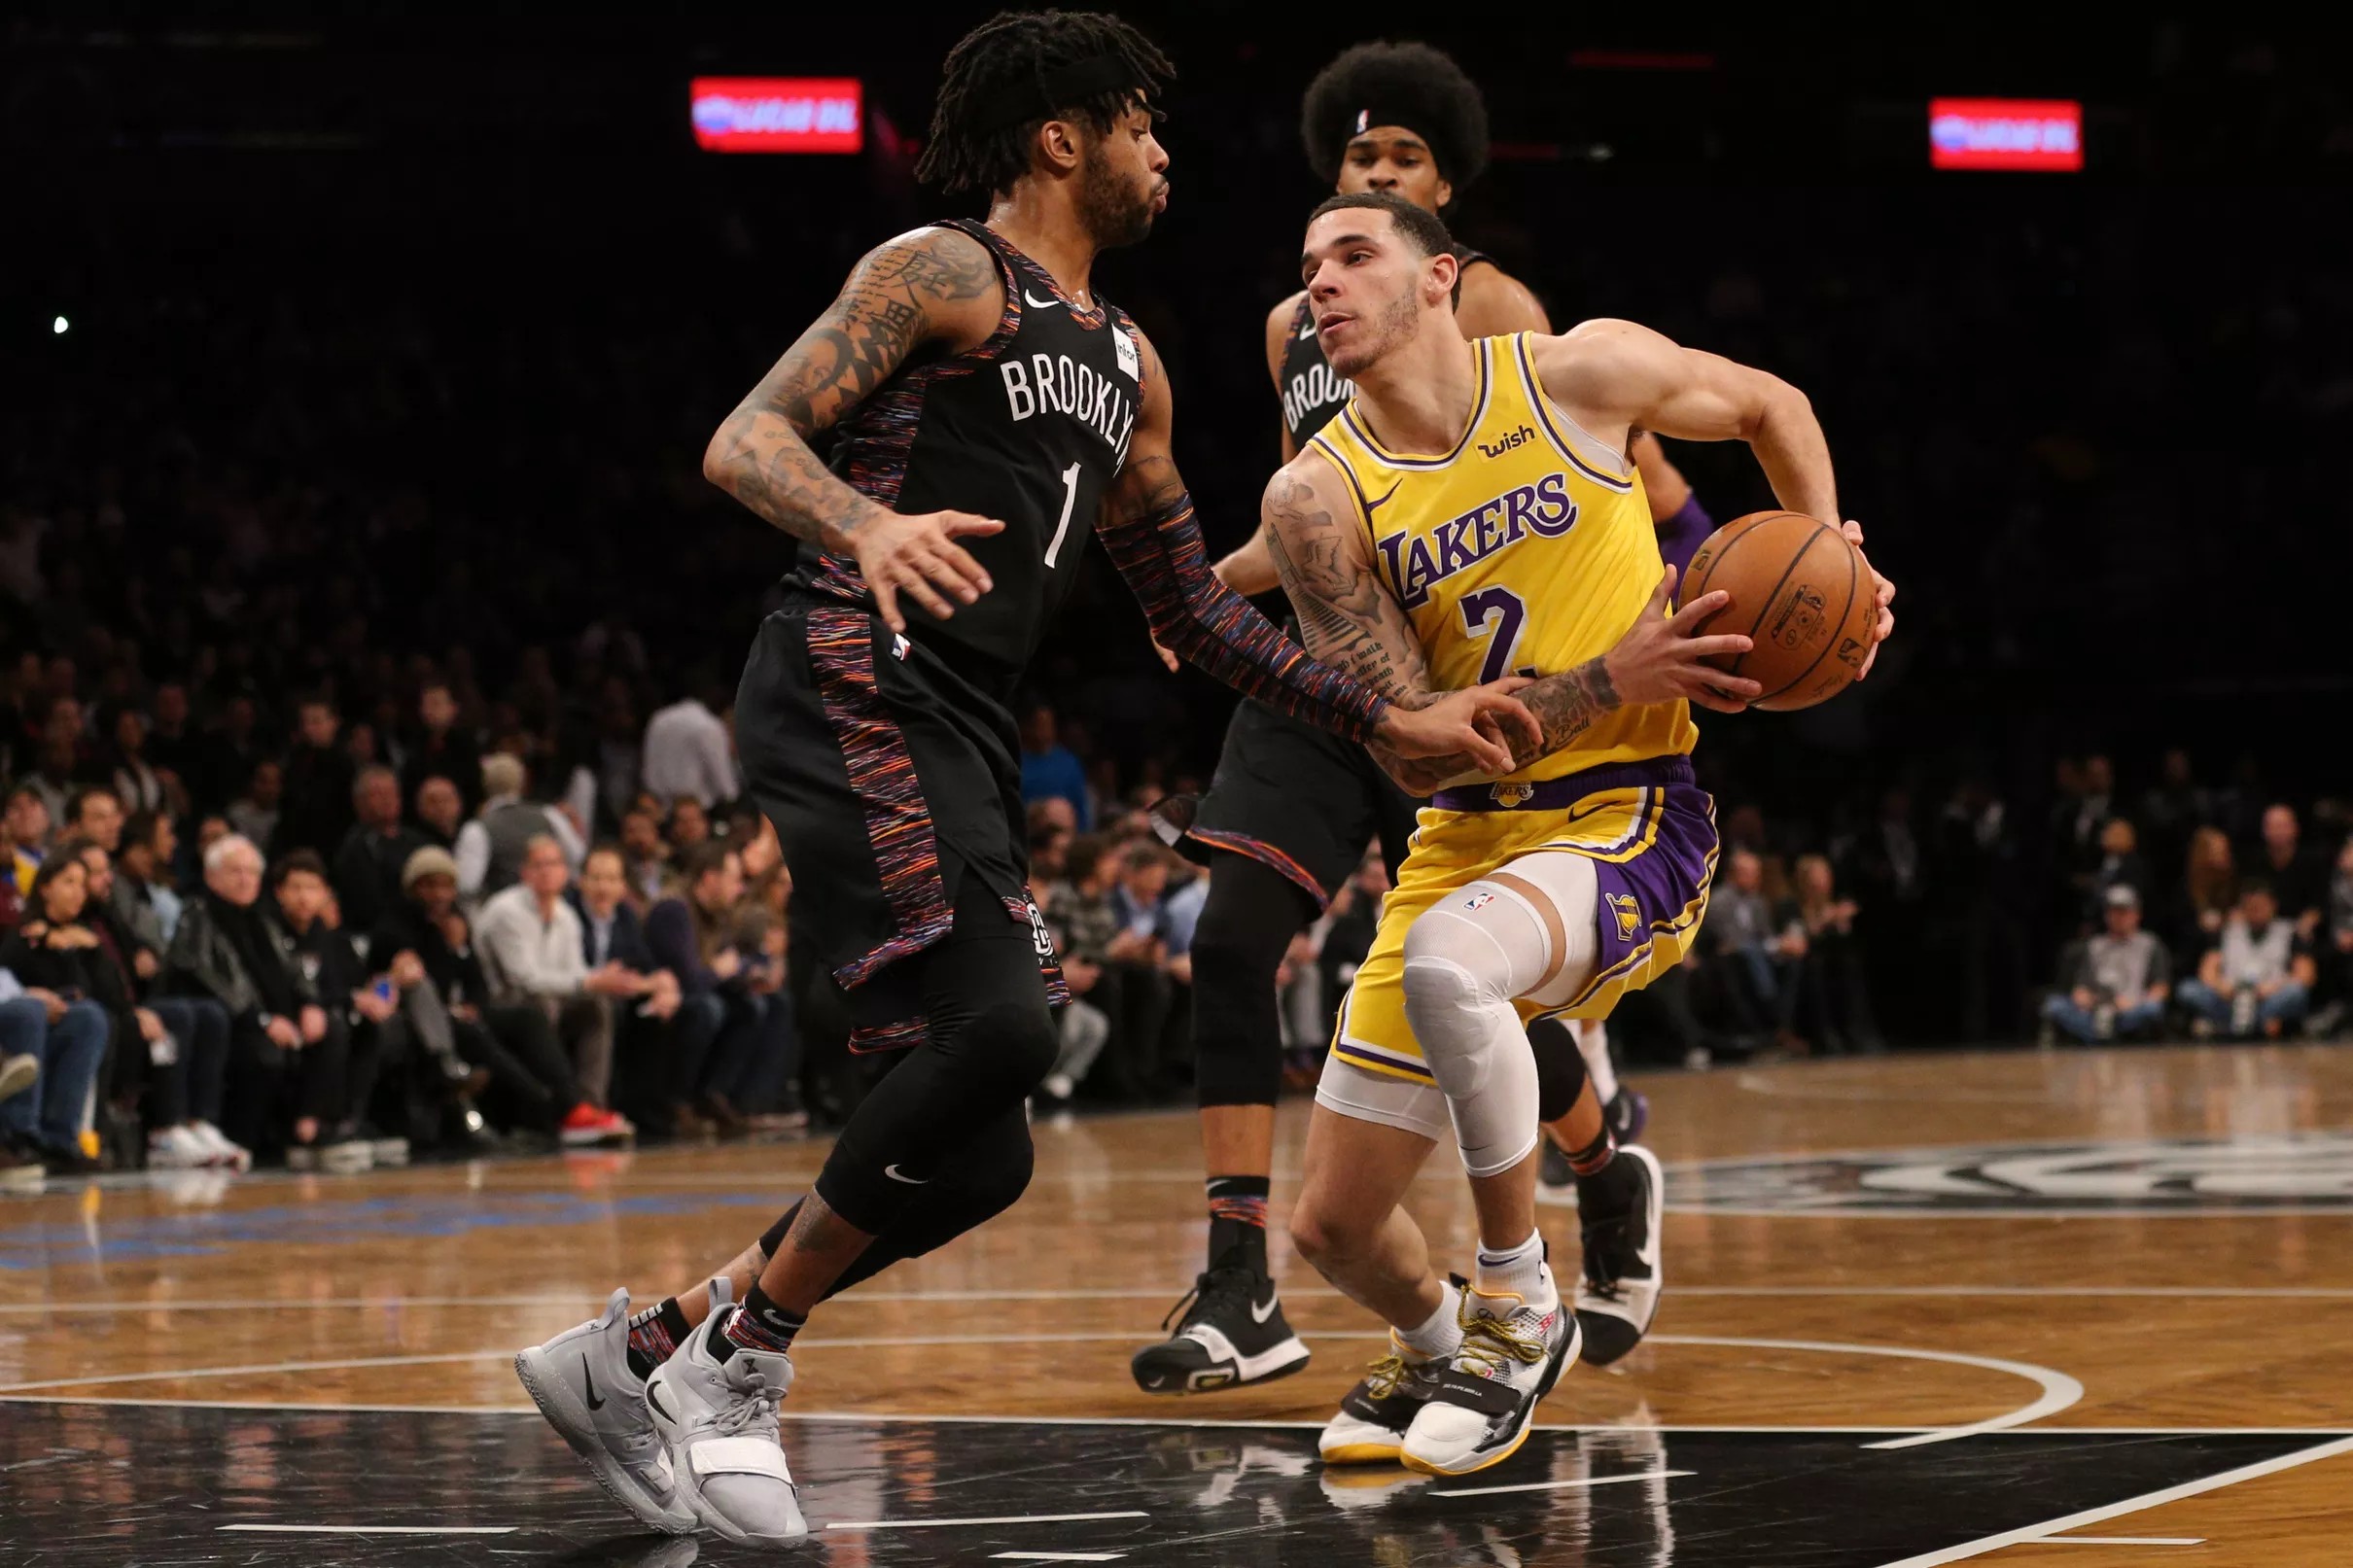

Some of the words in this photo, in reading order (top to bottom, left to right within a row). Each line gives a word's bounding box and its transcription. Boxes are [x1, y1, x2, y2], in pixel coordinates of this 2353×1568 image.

[1478, 425, 1535, 459] wish
[1043, 461, 1082, 569] 1
[1377, 472, 1579, 611] LAKERS
[1458, 583, 1539, 685] 2
